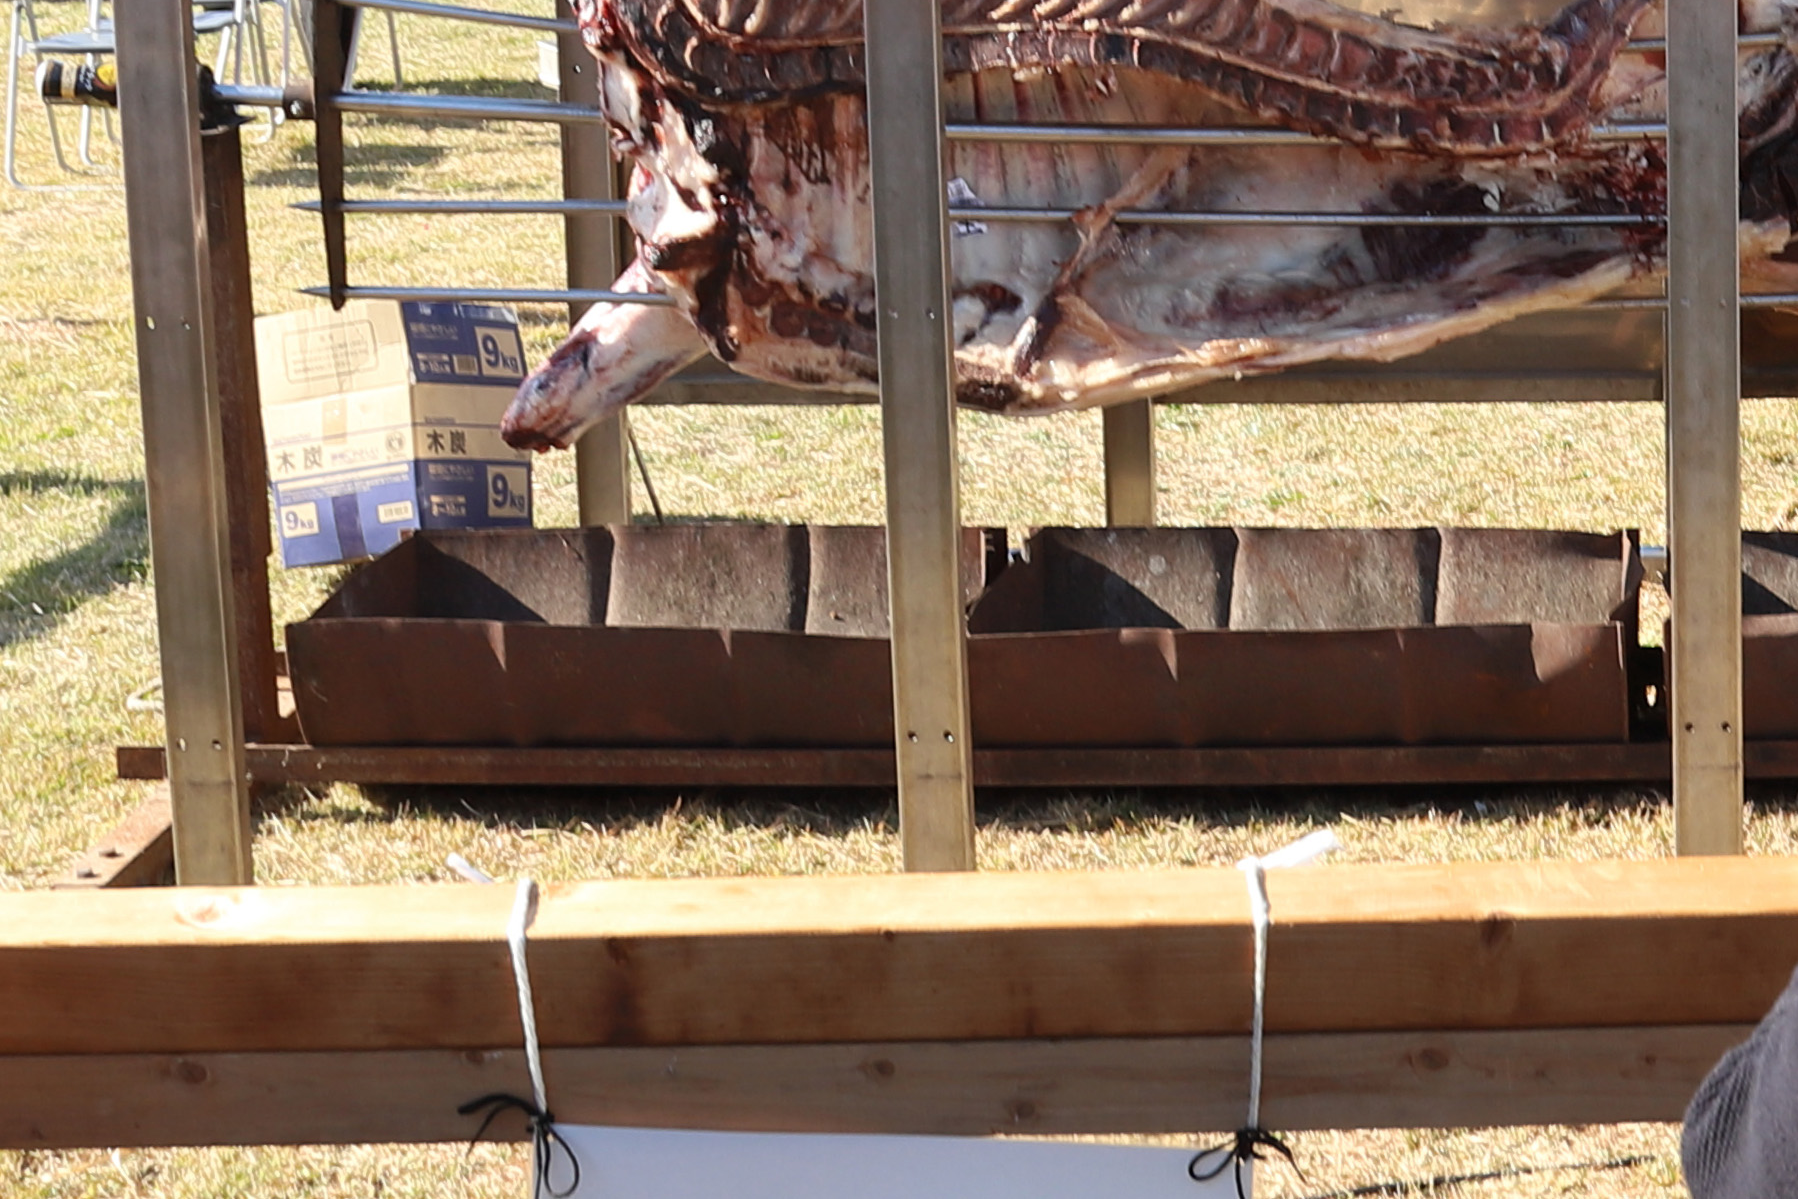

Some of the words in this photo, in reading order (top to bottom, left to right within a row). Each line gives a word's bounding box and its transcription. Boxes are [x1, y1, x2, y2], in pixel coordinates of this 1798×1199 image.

[482, 334, 520, 374] 9kg
[426, 429, 467, 455] 木炭
[275, 444, 323, 474] 木炭
[492, 473, 526, 513] 9kg
[285, 510, 315, 531] 9kg
